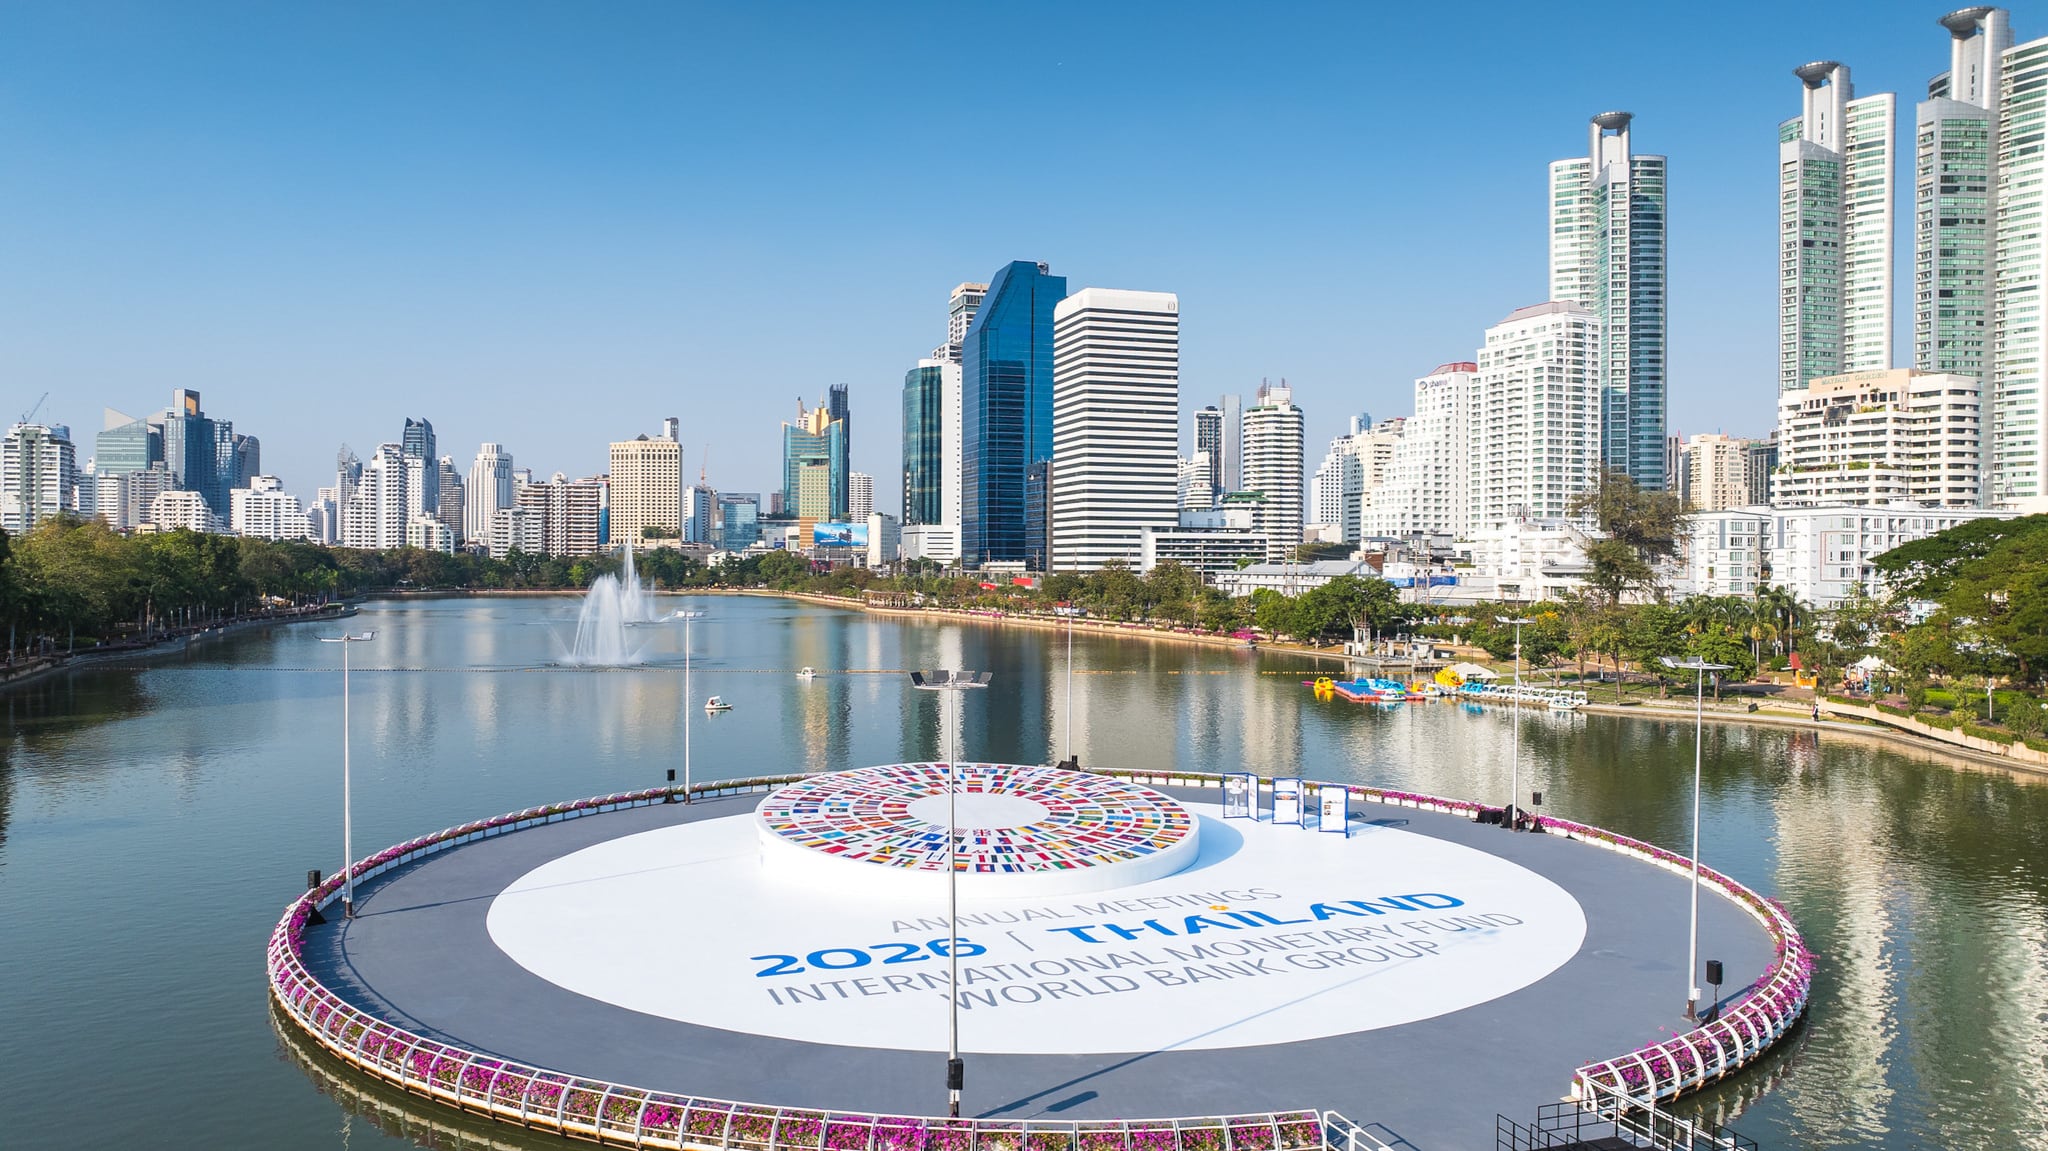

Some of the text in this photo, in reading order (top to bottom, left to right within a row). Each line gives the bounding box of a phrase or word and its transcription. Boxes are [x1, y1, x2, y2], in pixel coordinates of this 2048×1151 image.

[750, 893, 1465, 978] 2026 THAILAND
[892, 887, 1282, 933] ANNUAL MEETINGS
[767, 913, 1524, 1005] INTERNATIONAL MONETARY FUND
[940, 940, 1440, 1010] WORLD BANK GROUP
